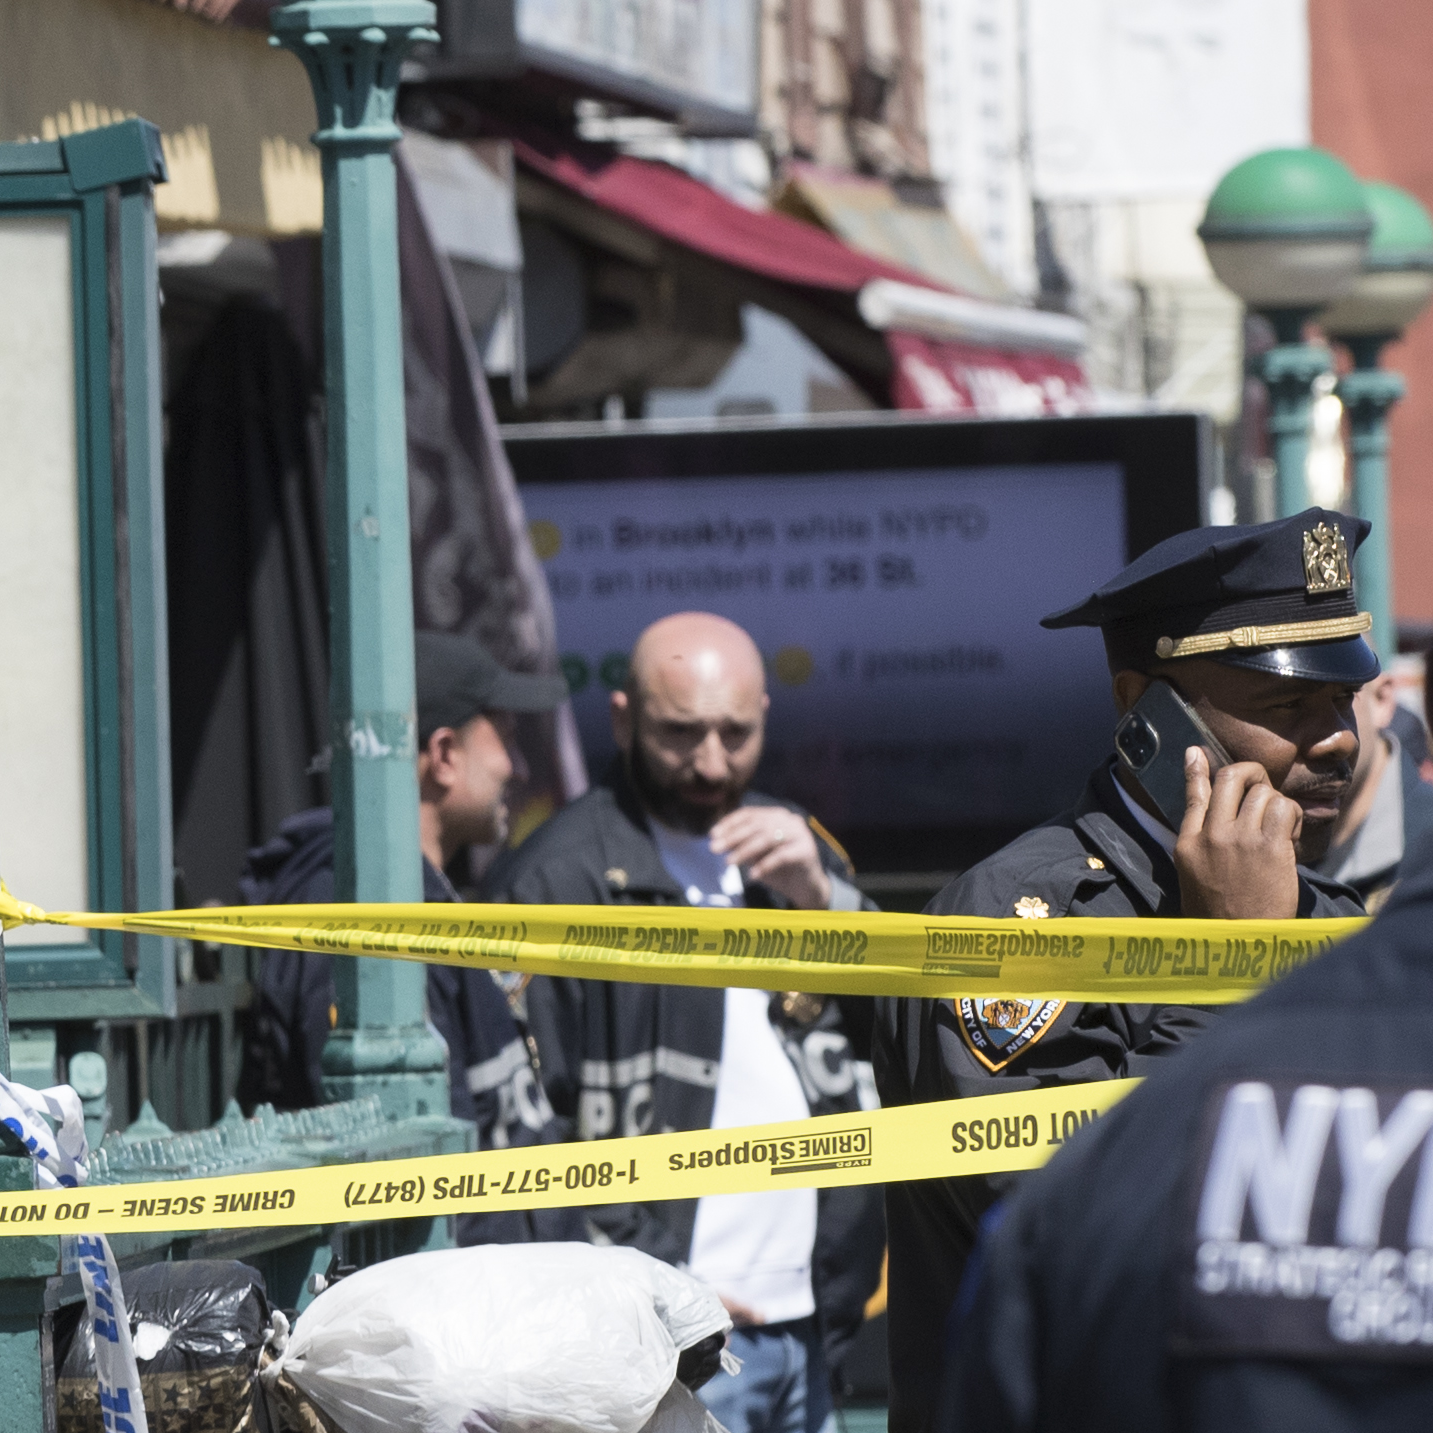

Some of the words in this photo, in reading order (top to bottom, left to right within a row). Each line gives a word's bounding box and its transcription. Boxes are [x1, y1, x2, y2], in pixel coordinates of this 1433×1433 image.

[951, 1114, 1039, 1154] CROSS
[669, 1132, 867, 1173] CRIMEstoppers
[344, 1175, 426, 1208] (8477)
[433, 1159, 640, 1200] 1-800-577-TIPS
[54, 1202, 90, 1221] DO
[120, 1195, 204, 1218] SCENE
[212, 1188, 296, 1212] CRIME
